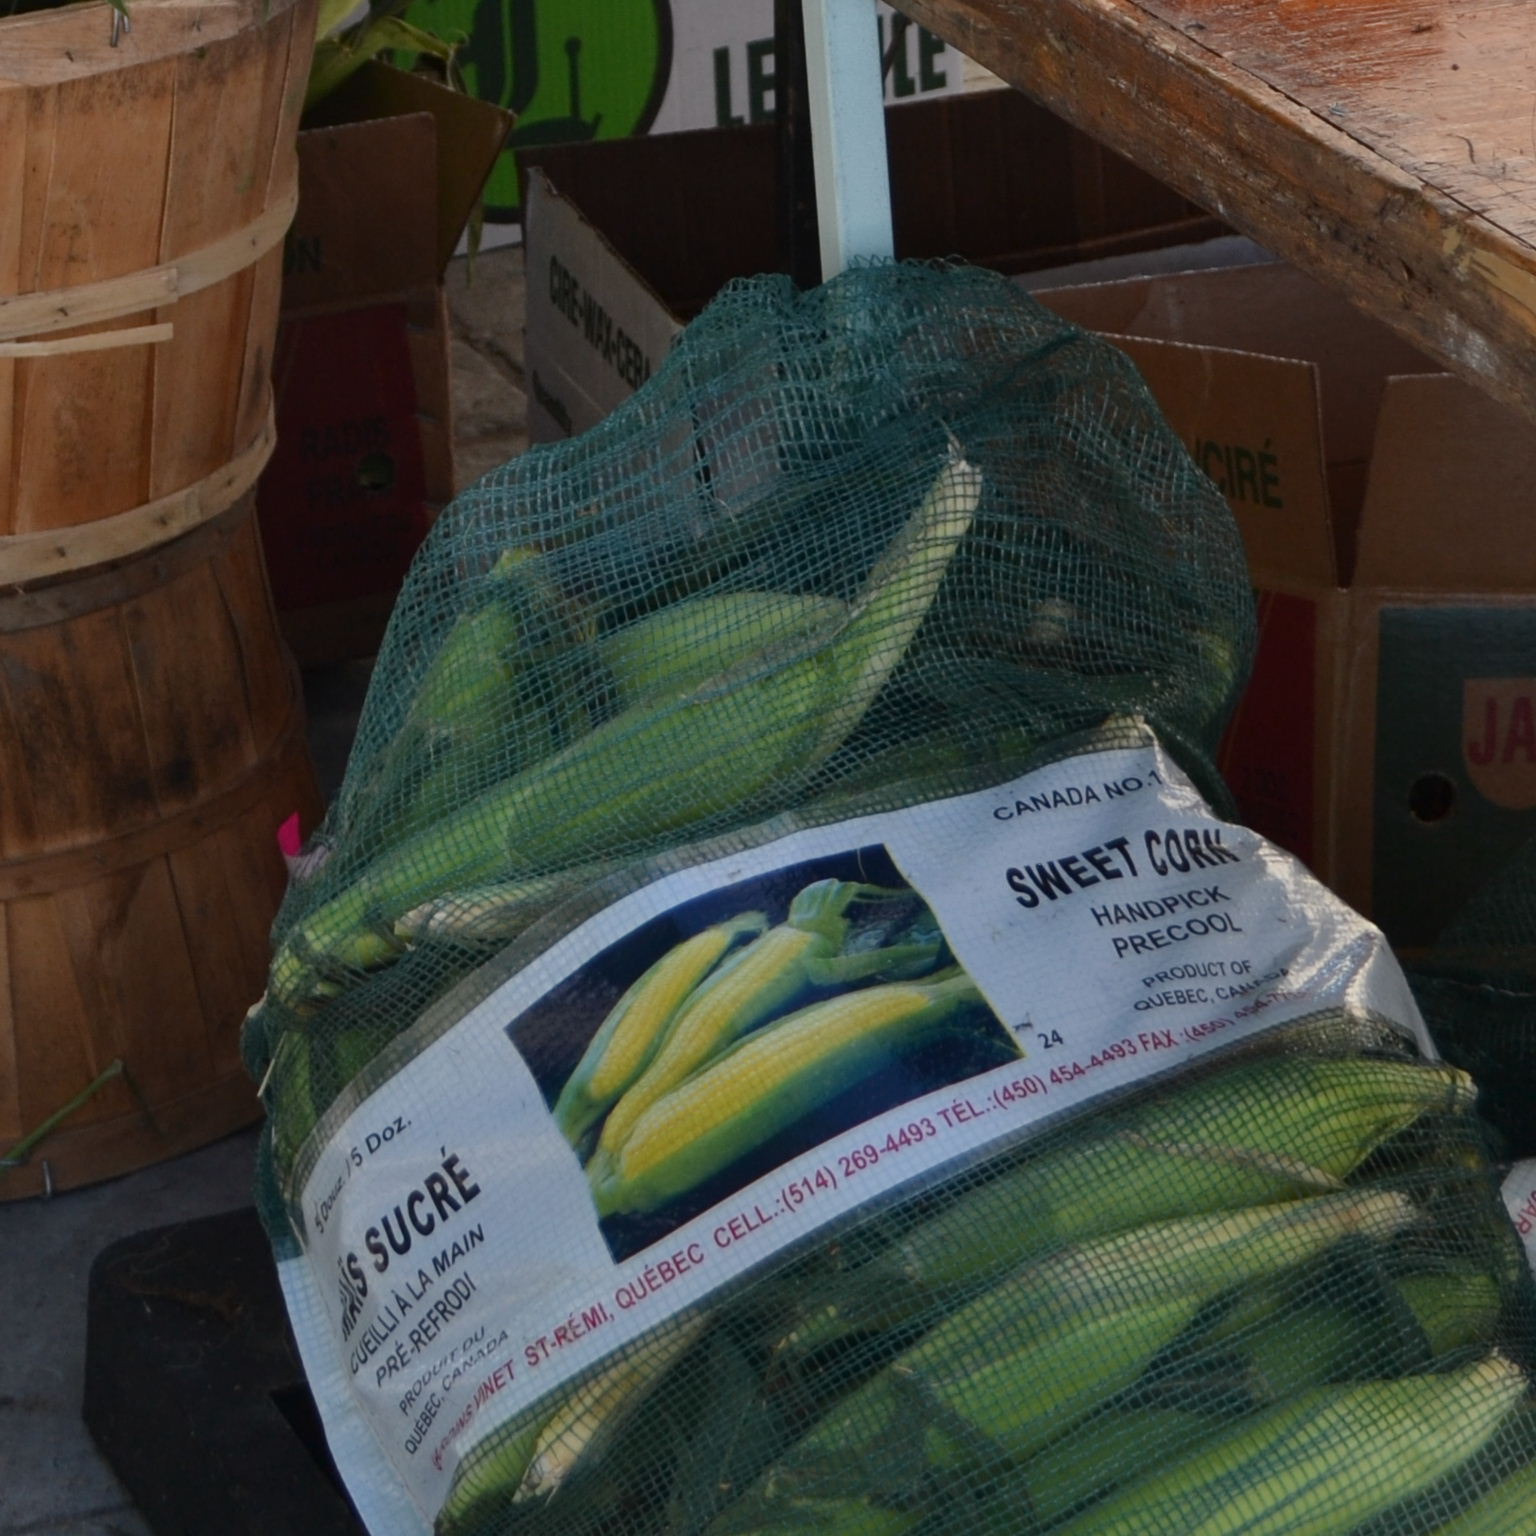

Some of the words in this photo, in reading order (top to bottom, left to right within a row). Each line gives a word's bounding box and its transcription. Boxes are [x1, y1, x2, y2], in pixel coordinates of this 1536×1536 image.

[993, 785, 1100, 820] CANADA
[1005, 836, 1138, 909] SWEET
[1144, 829, 1240, 876] CORN
[1090, 886, 1231, 927] HANDPICK
[1112, 912, 1242, 959] PRECOOL
[1133, 988, 1215, 1012] QUEBEC,
[1141, 961, 1226, 988] PRODUCT
[1230, 959, 1252, 975] OF
[1037, 1029, 1063, 1049] 24
[365, 1145, 481, 1273] SUCRÉ
[472, 1358, 517, 1413] VINET
[524, 1302, 615, 1367] ST-RÉMI,
[614, 1241, 706, 1312] QUÉBEC
[838, 1116, 938, 1178] 269-4493
[1049, 1038, 1138, 1087] 454-4493
[1139, 1028, 1178, 1053] FAX
[350, 1303, 400, 1375] CUEILLI
[390, 1289, 412, 1317] À
[405, 1269, 434, 1302] LA
[431, 1223, 485, 1277] MAIN
[375, 1271, 477, 1388] PRÉ-REFRODI
[399, 1349, 459, 1417] PRODUIT
[461, 1326, 486, 1355] DU
